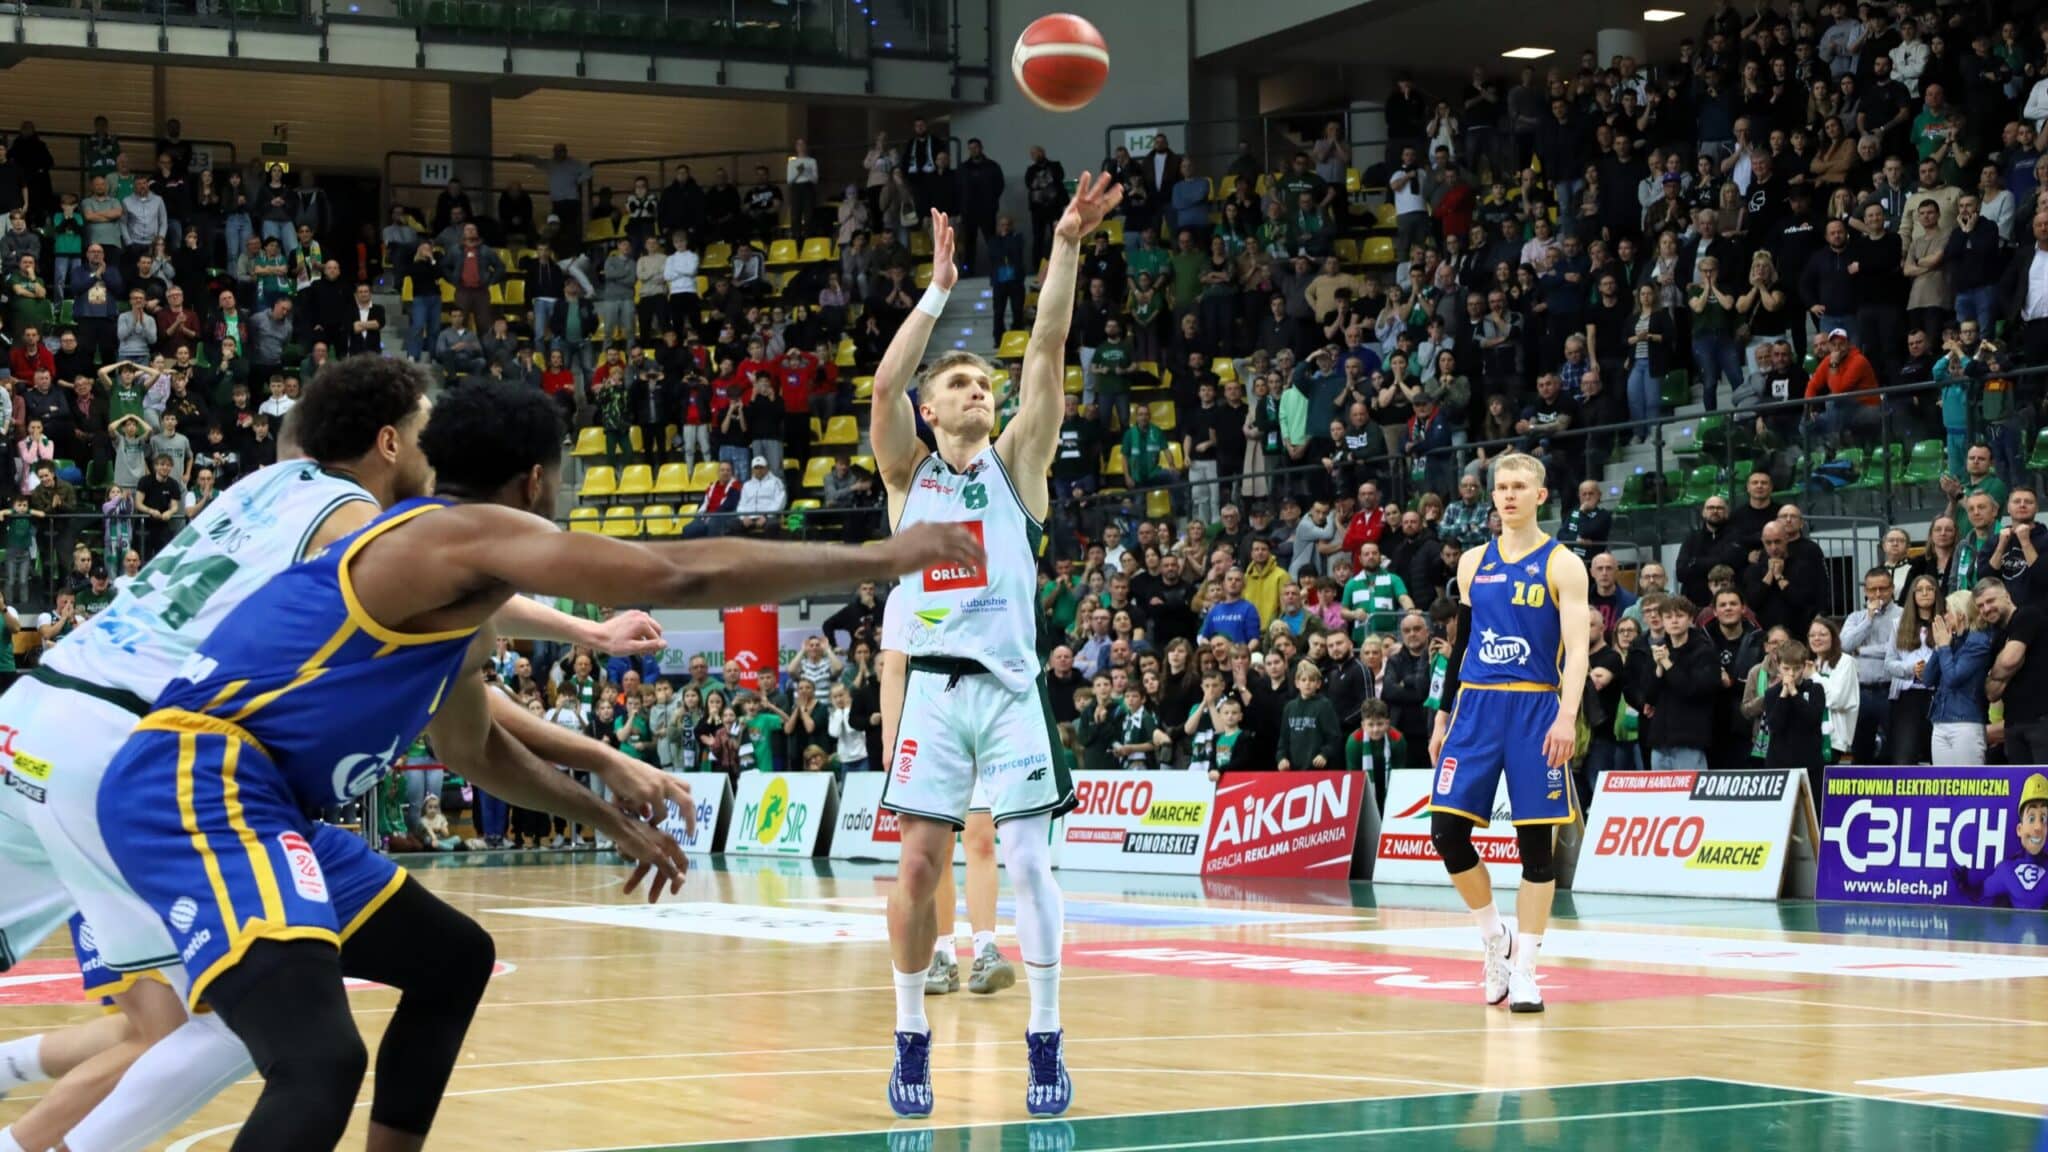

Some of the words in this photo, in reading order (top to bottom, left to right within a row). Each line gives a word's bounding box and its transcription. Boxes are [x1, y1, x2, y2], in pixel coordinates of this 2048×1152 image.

[425, 164, 448, 179] H1
[962, 482, 989, 510] 8
[1511, 580, 1546, 608] 10
[1485, 642, 1521, 660] LOTTO
[999, 752, 1048, 772] perceptus
[1608, 775, 1648, 789] CENTRUM
[1647, 774, 1692, 788] HANDLOWE
[1695, 774, 1785, 797] POMORSKIE
[1828, 778, 1894, 796] HURTOWNIA
[1895, 778, 2010, 797] ELEKTROTECHNICZNA
[1072, 780, 1153, 817] BRICO
[842, 811, 873, 831] radio
[1127, 834, 1196, 853] POMORSKIE
[1594, 815, 1705, 858] BRICO
[1205, 852, 1242, 873] KREACJA
[1244, 843, 1290, 863] REKLAMA
[1291, 826, 1347, 853] DRUKARNIA
[1383, 838, 1392, 856] Z
[1393, 839, 1424, 857] NAMI
[1843, 879, 1948, 899] www.blech.pl
